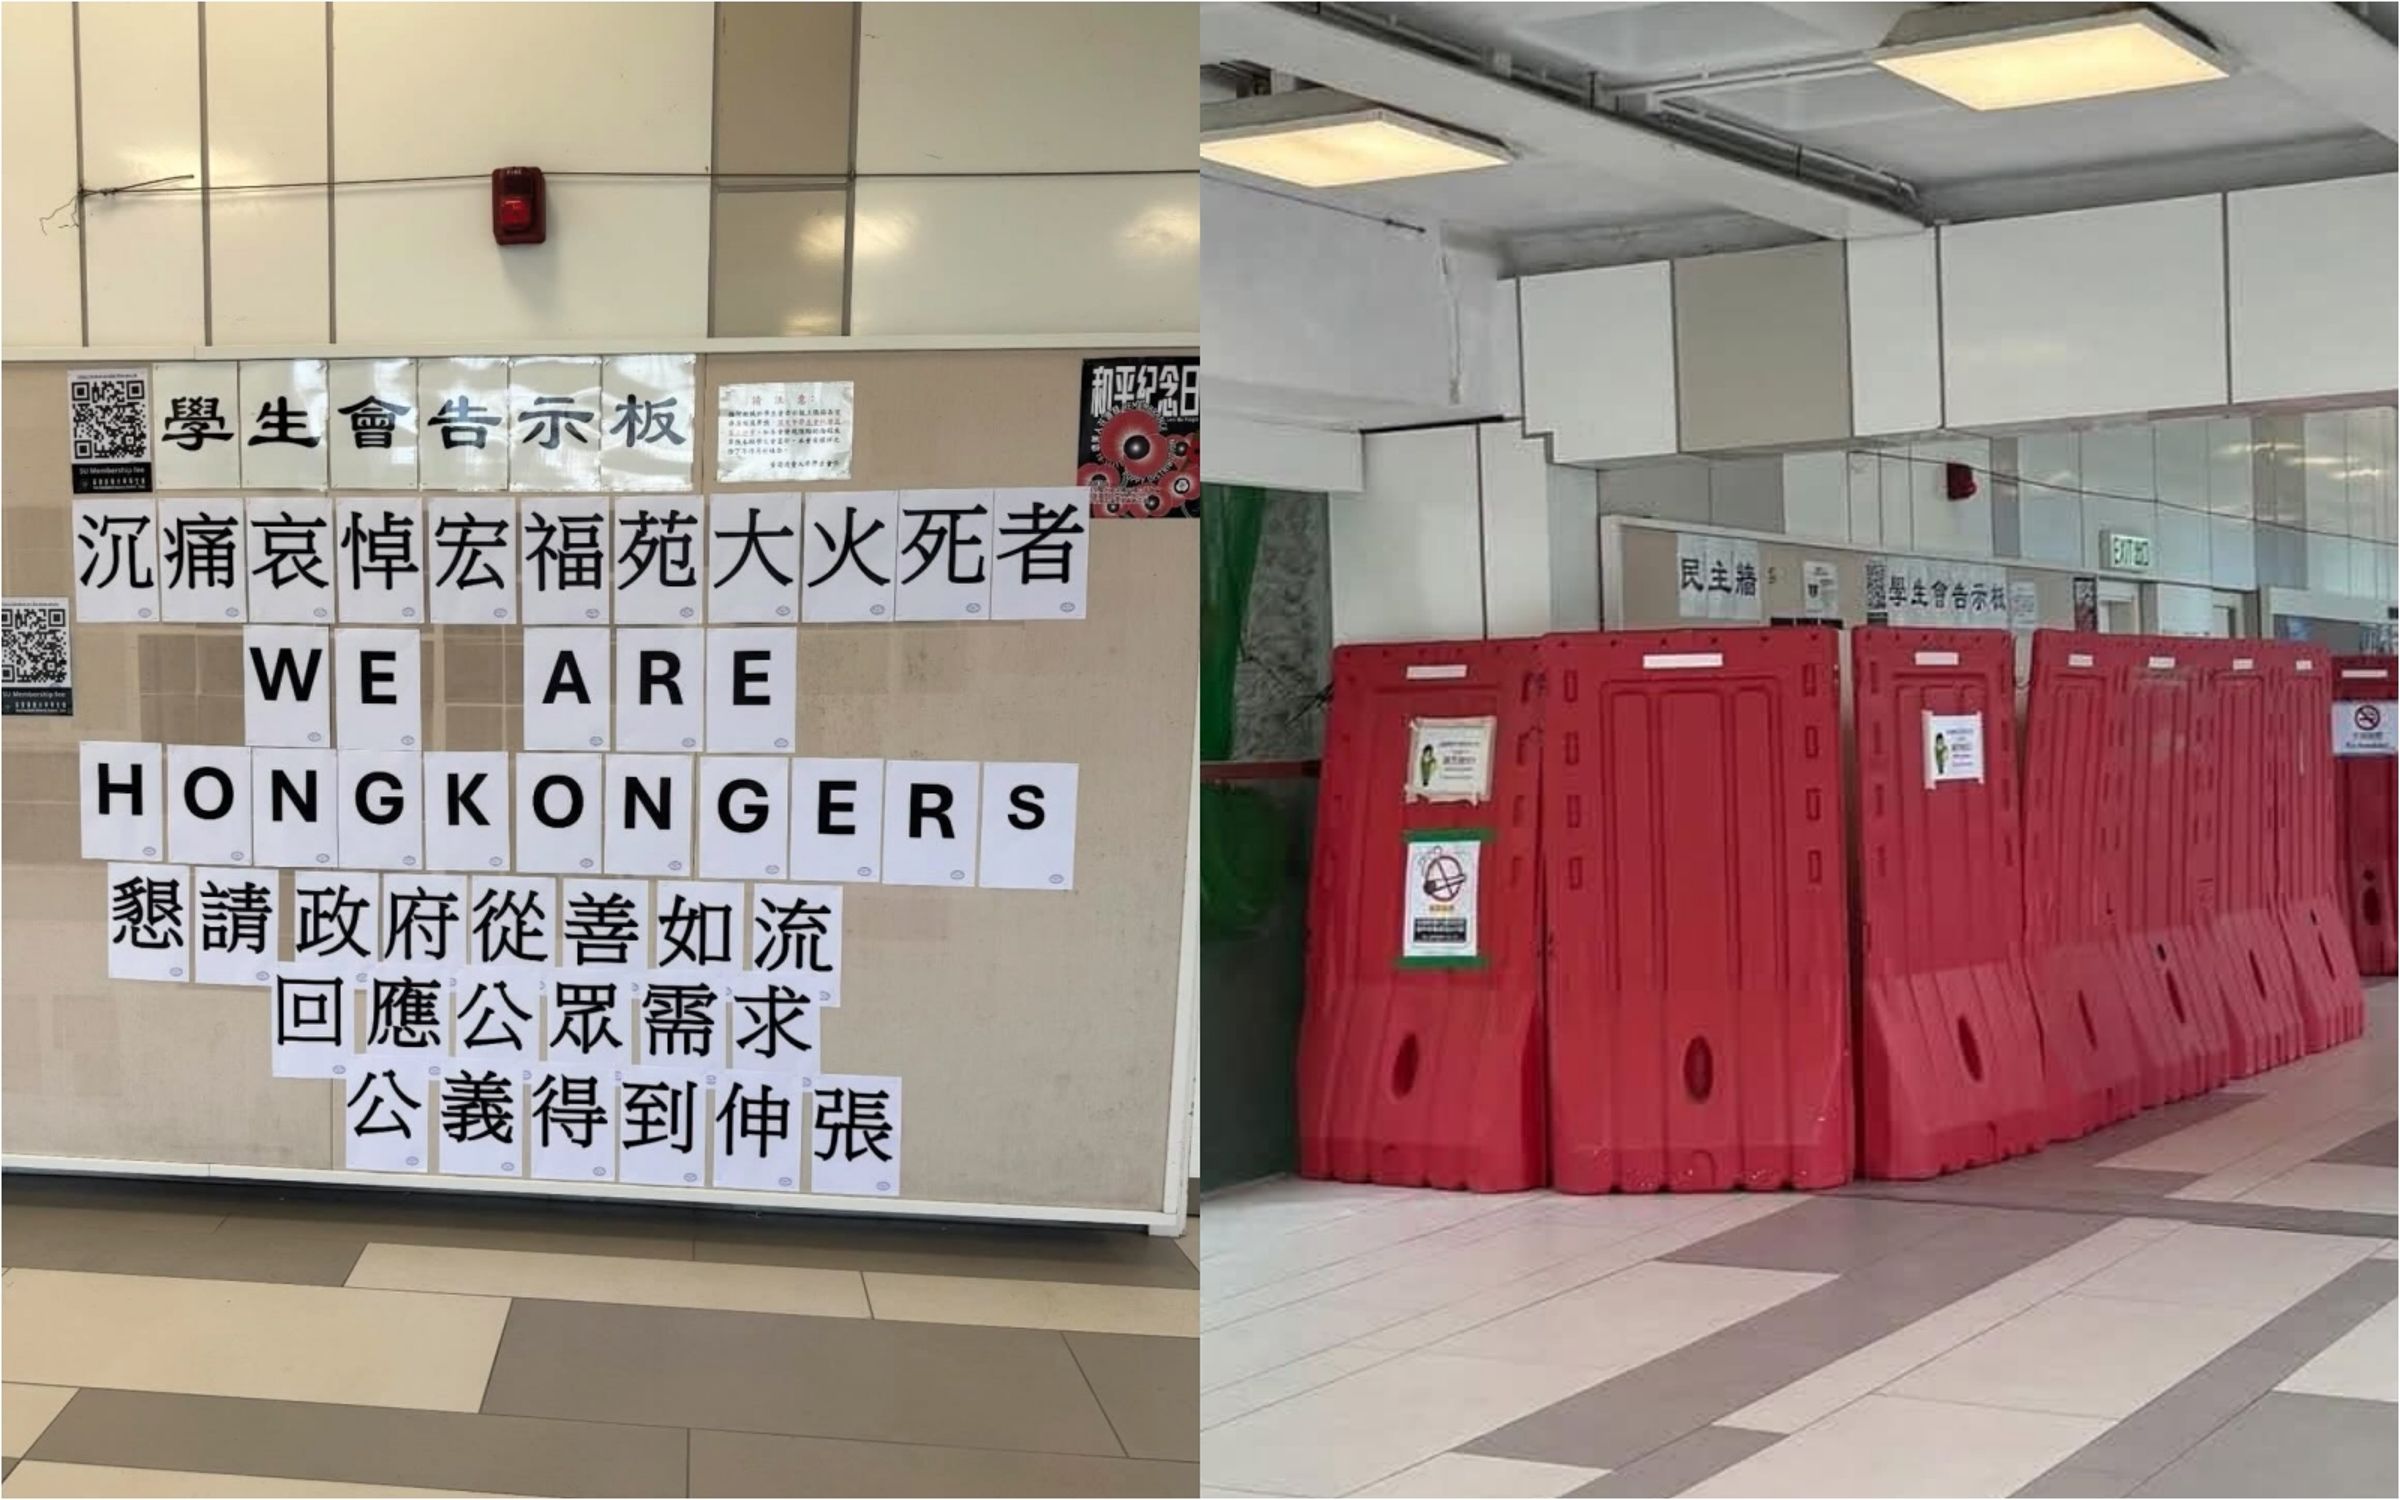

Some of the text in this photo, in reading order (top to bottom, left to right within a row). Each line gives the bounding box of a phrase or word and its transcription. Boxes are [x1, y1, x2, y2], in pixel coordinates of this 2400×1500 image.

[161, 393, 687, 452] 學生會告示板
[78, 501, 1085, 591] 沉痛哀悼宏福苑大火死者
[249, 646, 771, 706] WE ARE
[97, 762, 1046, 839] HONGKONGERS
[276, 973, 812, 1059] 回應公眾需求
[346, 1068, 893, 1163] 公義得到伸張
